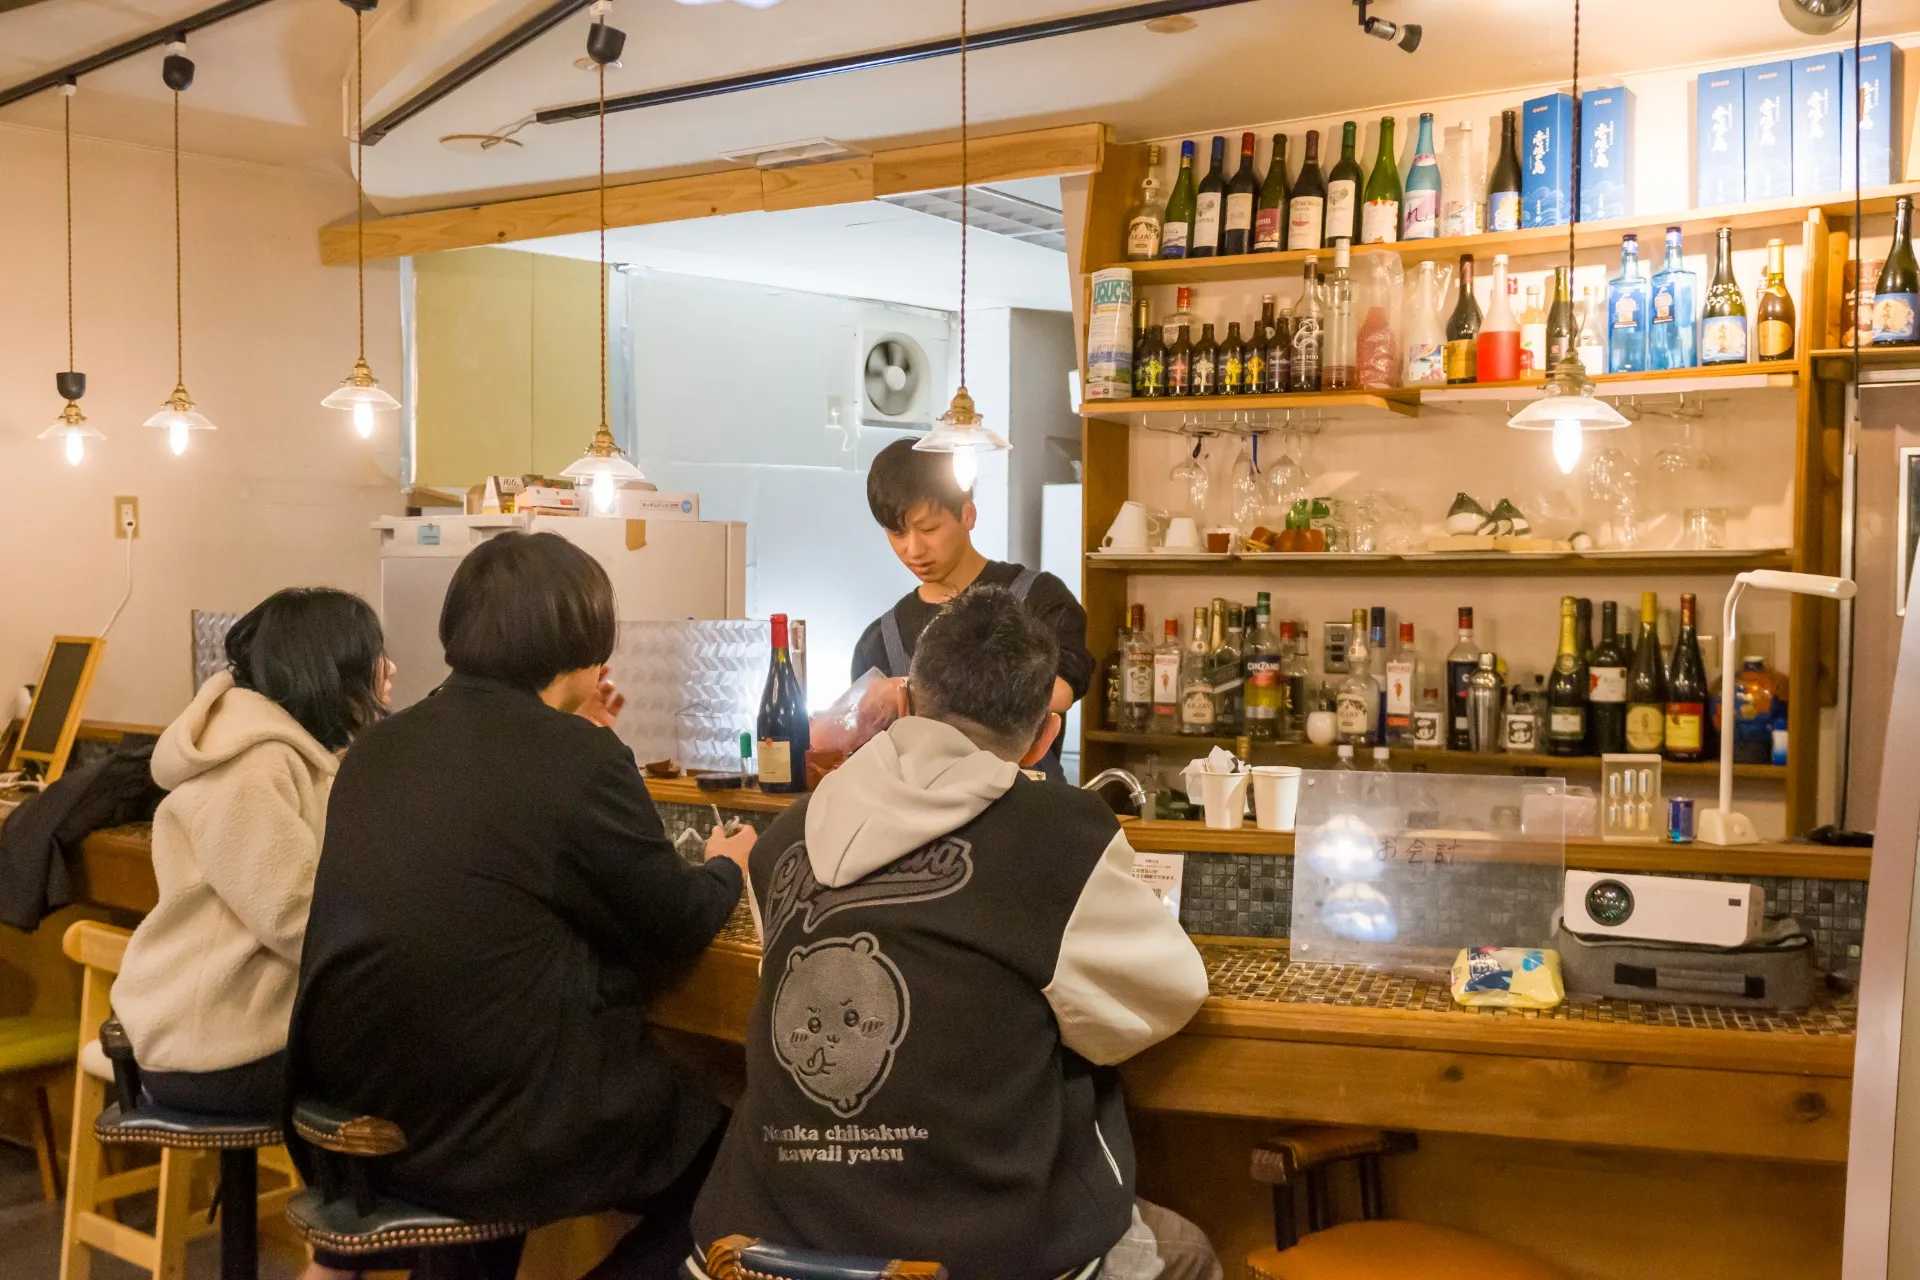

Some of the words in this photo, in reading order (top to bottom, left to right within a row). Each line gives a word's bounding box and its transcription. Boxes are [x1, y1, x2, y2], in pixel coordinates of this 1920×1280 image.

[1247, 661, 1280, 671] CINZANO
[1376, 838, 1461, 865] お会計
[762, 1124, 820, 1142] Nanka
[825, 1124, 929, 1142] chiisakute
[778, 1145, 842, 1162] kawaii
[848, 1146, 904, 1165] yatsu
